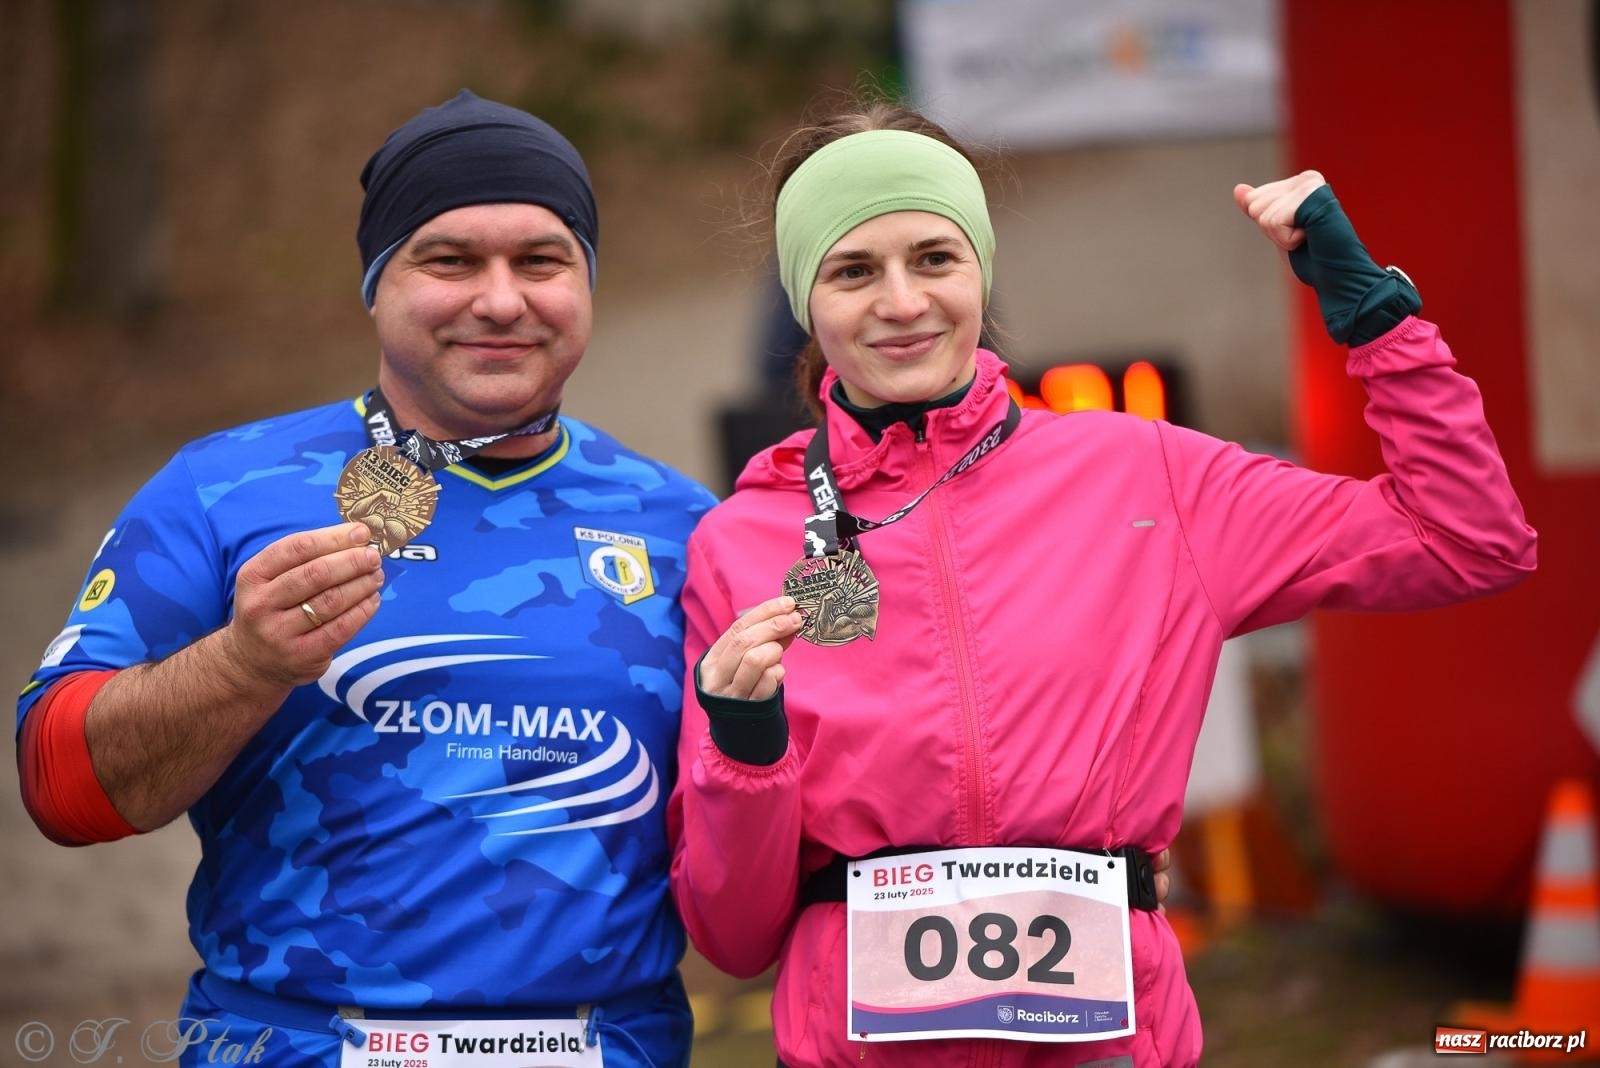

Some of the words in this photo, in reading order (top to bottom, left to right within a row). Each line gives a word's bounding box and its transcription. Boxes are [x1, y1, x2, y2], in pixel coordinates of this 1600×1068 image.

[379, 459, 411, 488] BIEG
[597, 532, 642, 546] POLONIA
[802, 569, 837, 586] BIEG
[373, 699, 606, 742] ZŁOM-MAX
[447, 743, 494, 760] Firma
[499, 745, 579, 765] Handlowa
[873, 863, 935, 887] BIEG
[941, 857, 1100, 885] Twardziela
[873, 891, 886, 900] 23
[887, 890, 909, 899] luty
[909, 887, 934, 897] 2025
[903, 912, 1075, 985] 082
[1017, 1009, 1080, 1024] Racibórz
[368, 1032, 430, 1053] BIEG
[437, 1031, 582, 1054] Twardziela
[367, 1058, 379, 1067] 23
[381, 1058, 402, 1068] luty
[403, 1059, 428, 1068] 2025
